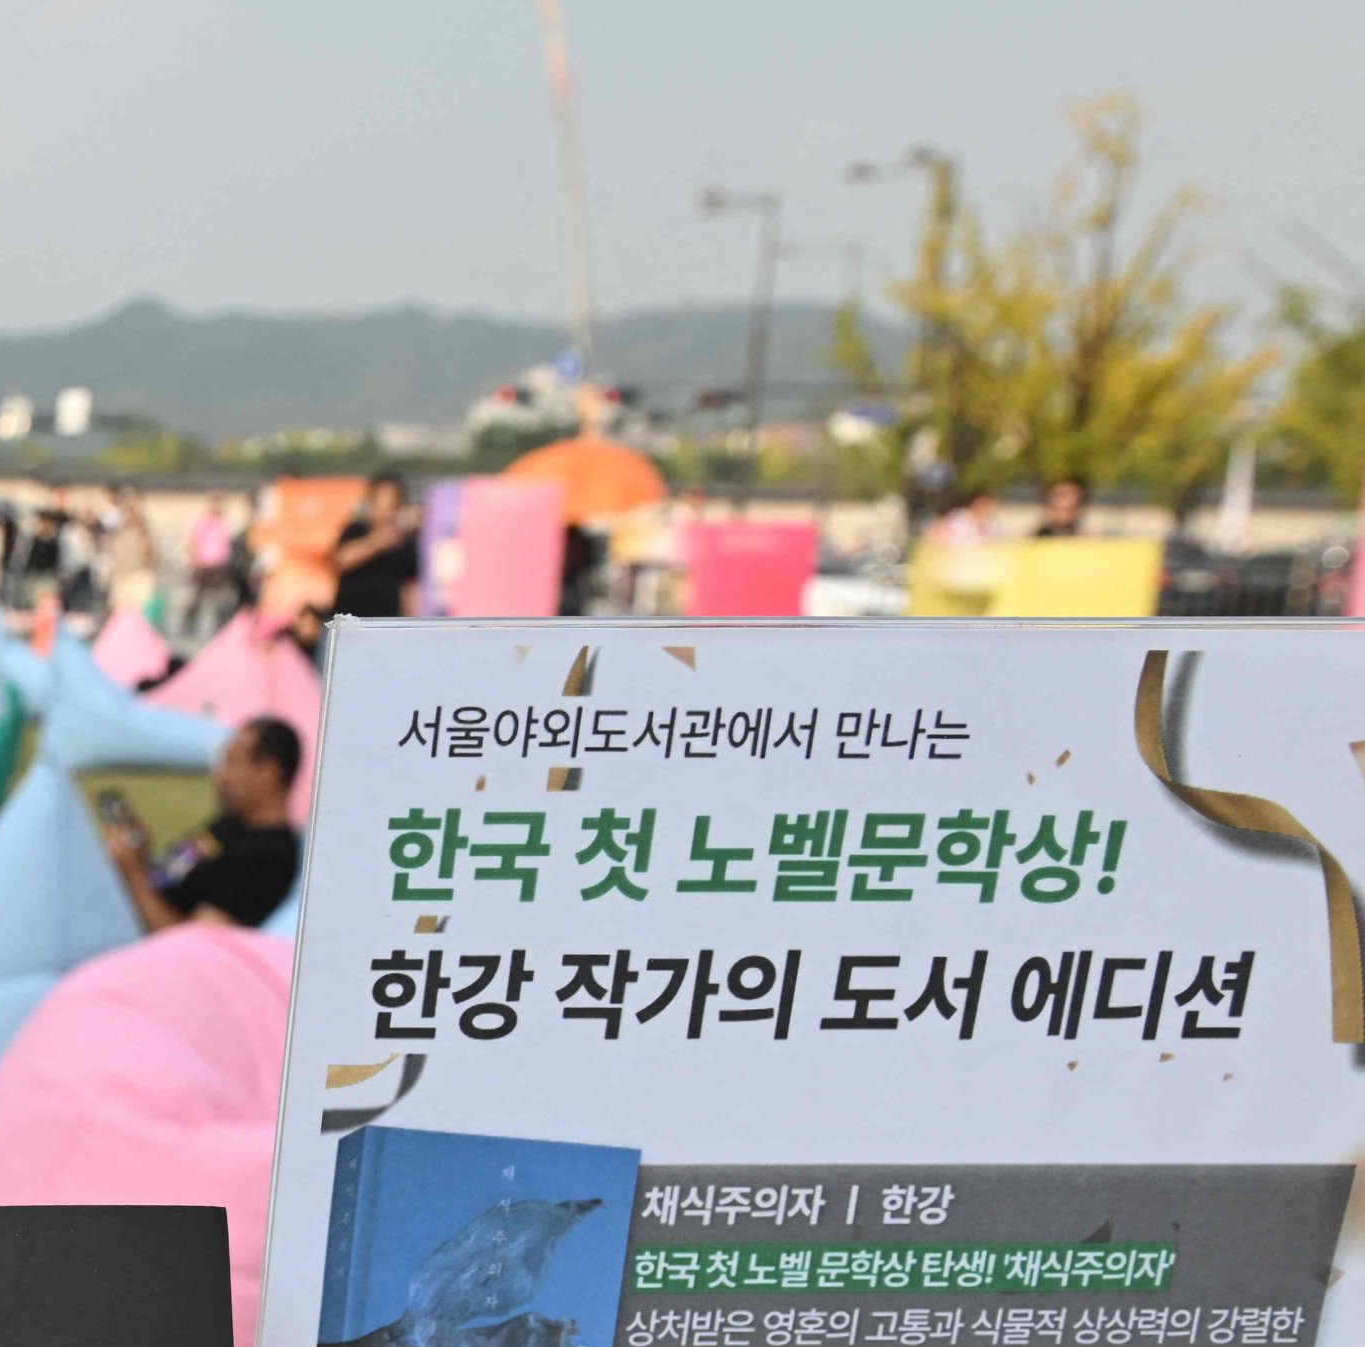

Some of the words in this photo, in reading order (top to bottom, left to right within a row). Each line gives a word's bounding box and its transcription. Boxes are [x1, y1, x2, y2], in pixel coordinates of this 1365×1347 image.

[399, 706, 818, 759] 서울야외도서관에서
[836, 708, 970, 759] 만나는
[388, 808, 550, 902] 한국
[576, 808, 656, 901] 첫
[677, 809, 1127, 903] 노벨문학상!
[371, 950, 534, 1040] 한강
[556, 950, 801, 1040] 작가의
[820, 950, 988, 1040] 도서
[1011, 950, 1255, 1040] 에디션
[642, 1185, 825, 1225] 채식주의자
[883, 1185, 954, 1224] 한강
[636, 1252, 700, 1288] 한국
[707, 1251, 739, 1287] 첫
[744, 1251, 811, 1287] 노벨
[817, 1251, 917, 1287] 문학상
[922, 1251, 996, 1287] 탄생!
[1004, 1250, 1175, 1286] '채식주의자'
[626, 1309, 755, 1347] 상처받은
[764, 1309, 859, 1345] 영혼의
[865, 1308, 964, 1345] 고통과
[972, 1308, 1066, 1344] 식물적
[1074, 1307, 1200, 1344] 상상력의
[1208, 1307, 1304, 1344] 강렬한
